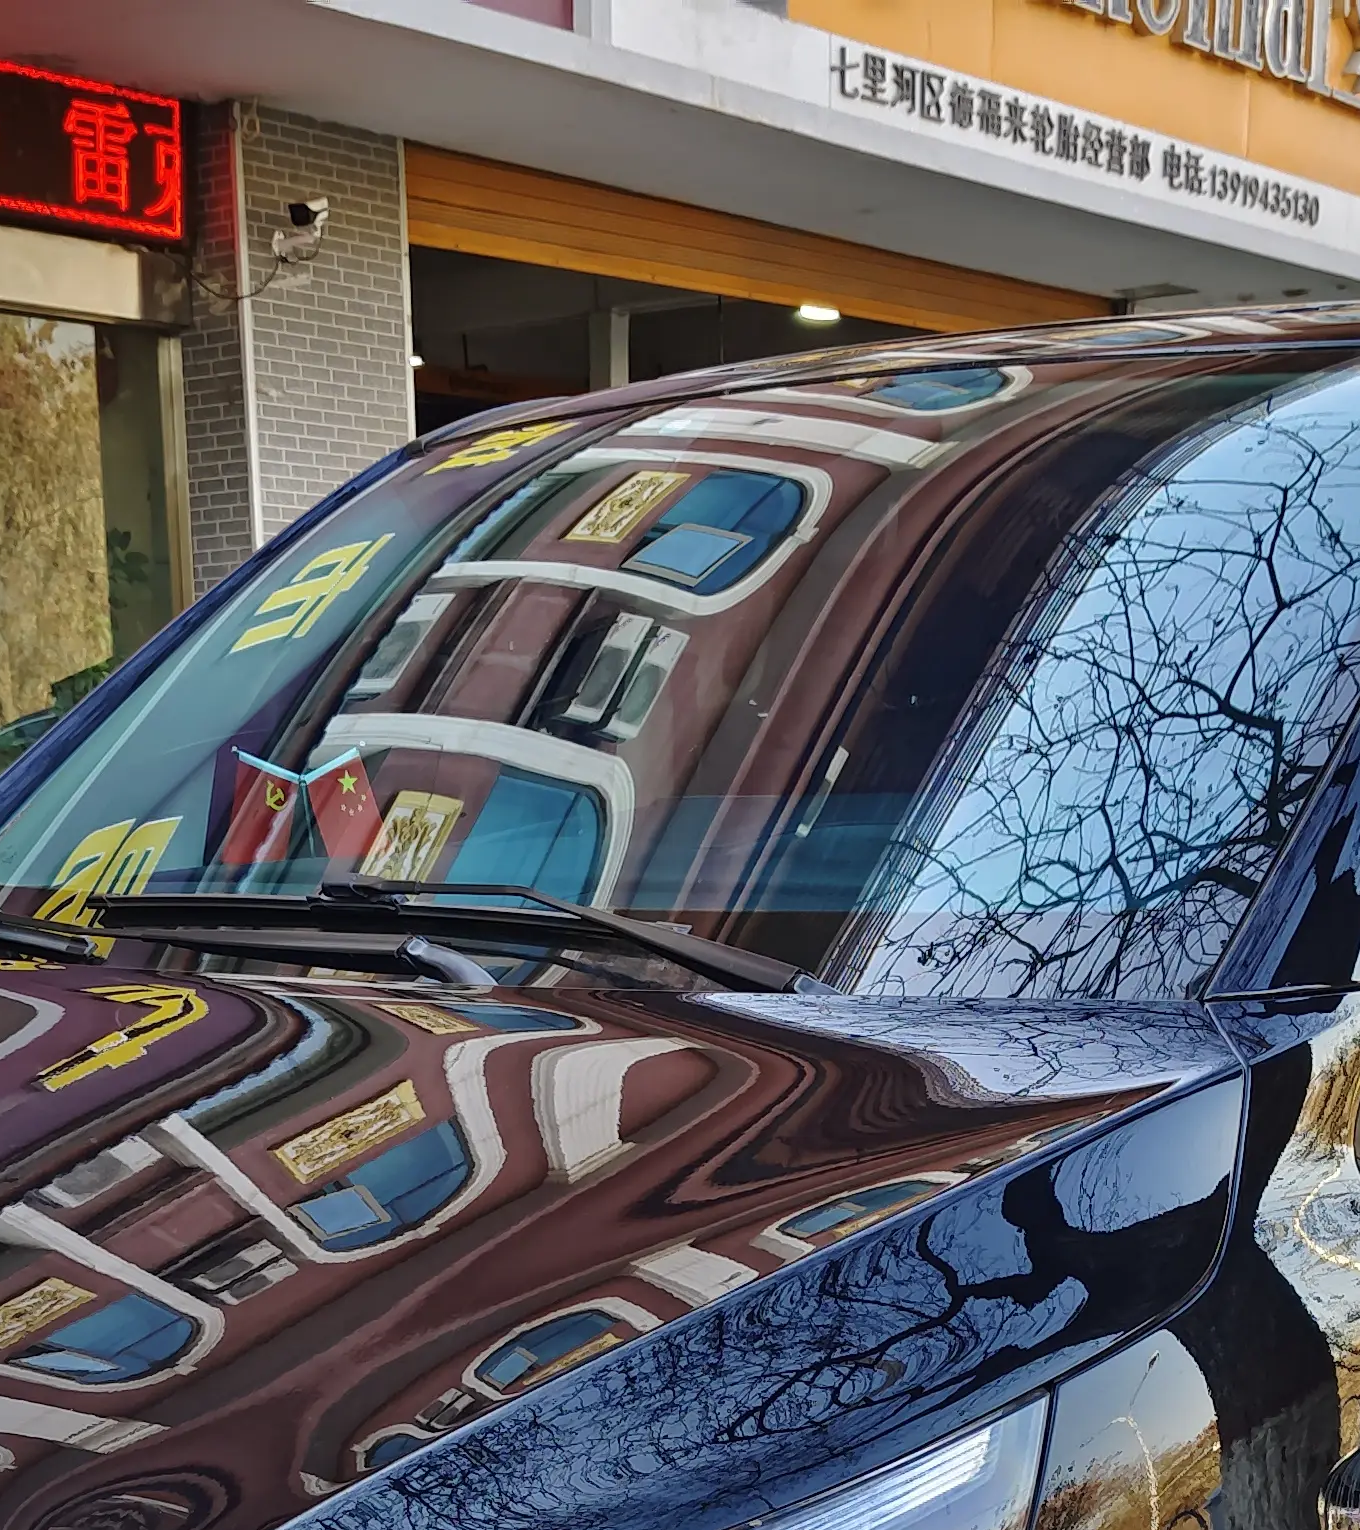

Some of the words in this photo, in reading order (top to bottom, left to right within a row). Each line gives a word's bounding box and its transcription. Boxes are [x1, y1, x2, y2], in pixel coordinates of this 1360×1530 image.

[831, 46, 1151, 182] 七里河区德福来轮胎经营部
